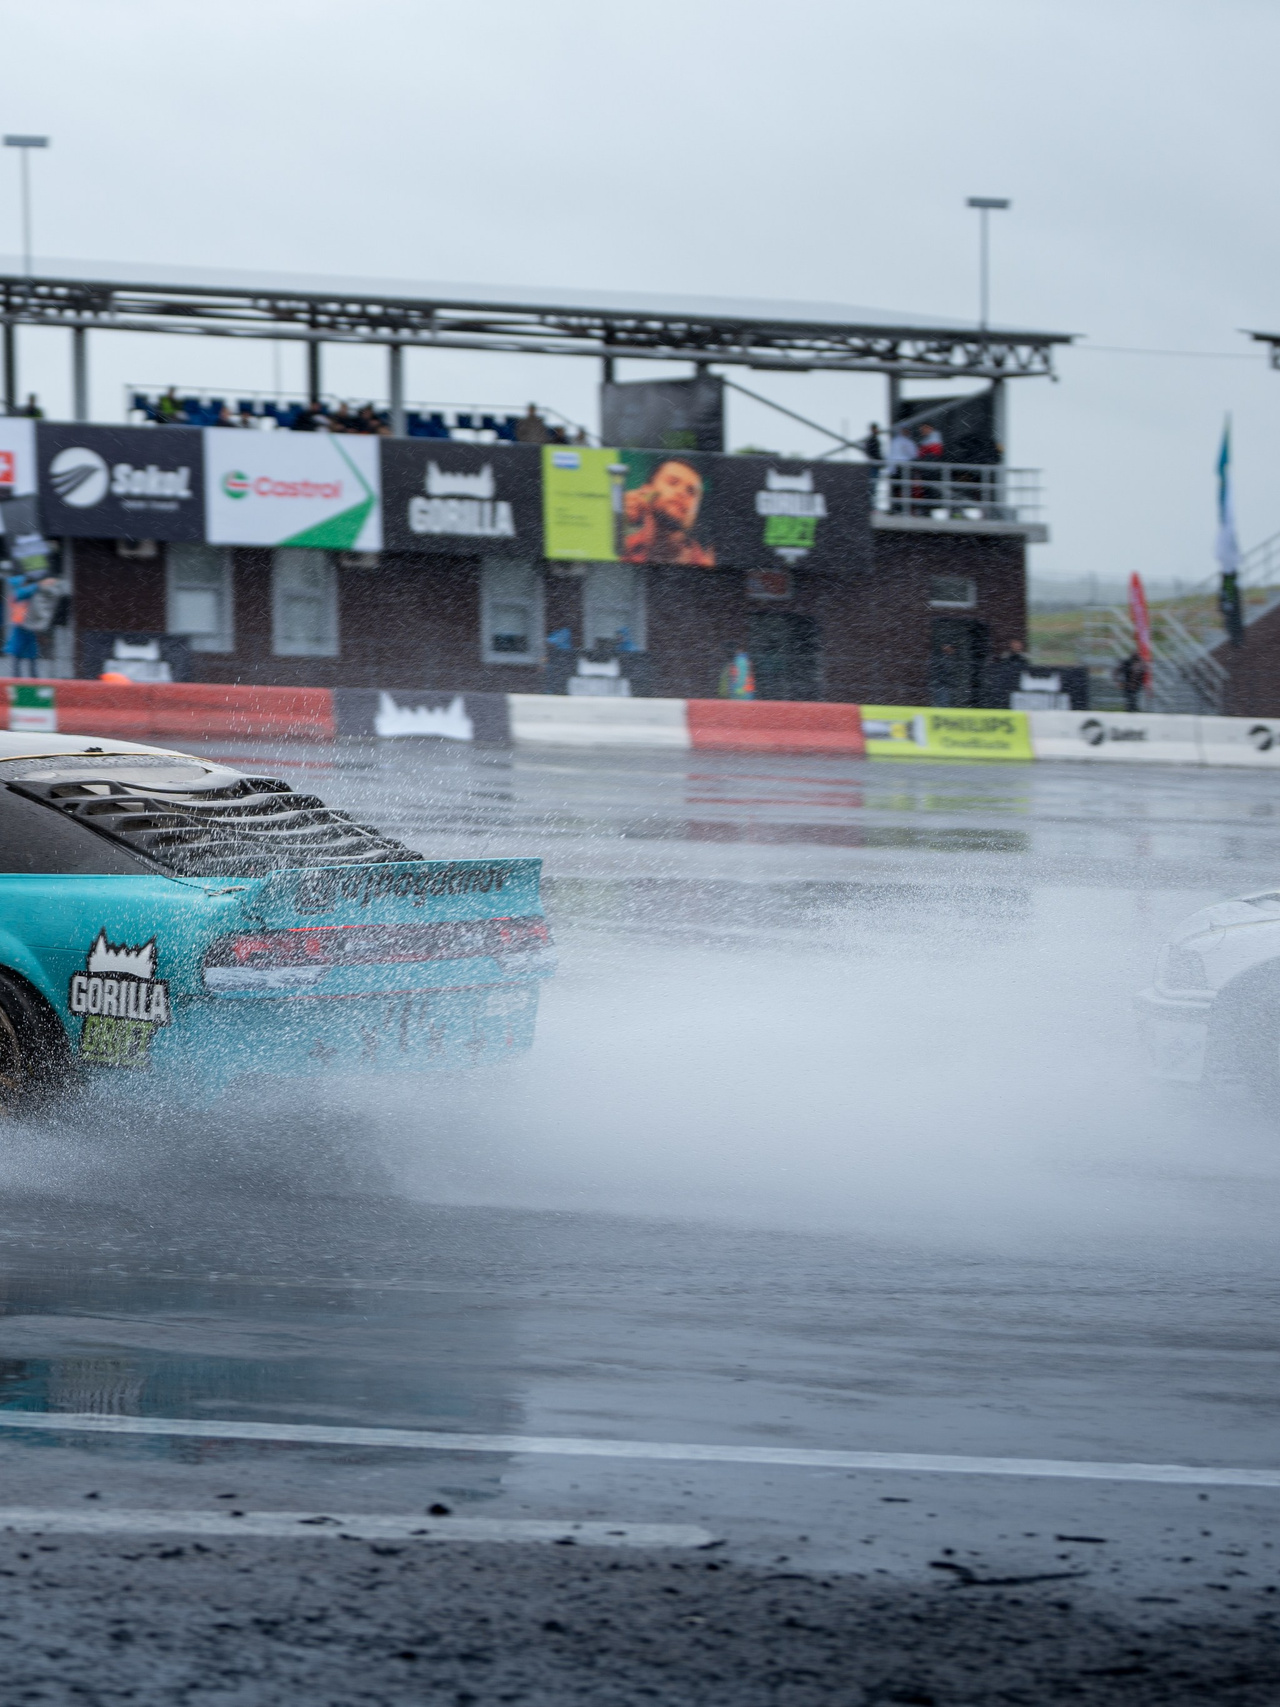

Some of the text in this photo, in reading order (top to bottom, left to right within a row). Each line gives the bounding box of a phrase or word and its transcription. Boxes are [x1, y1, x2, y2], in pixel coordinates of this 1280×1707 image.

[253, 476, 342, 500] Castrol
[408, 496, 516, 537] GORILLA
[70, 975, 169, 1023] GORILLA
